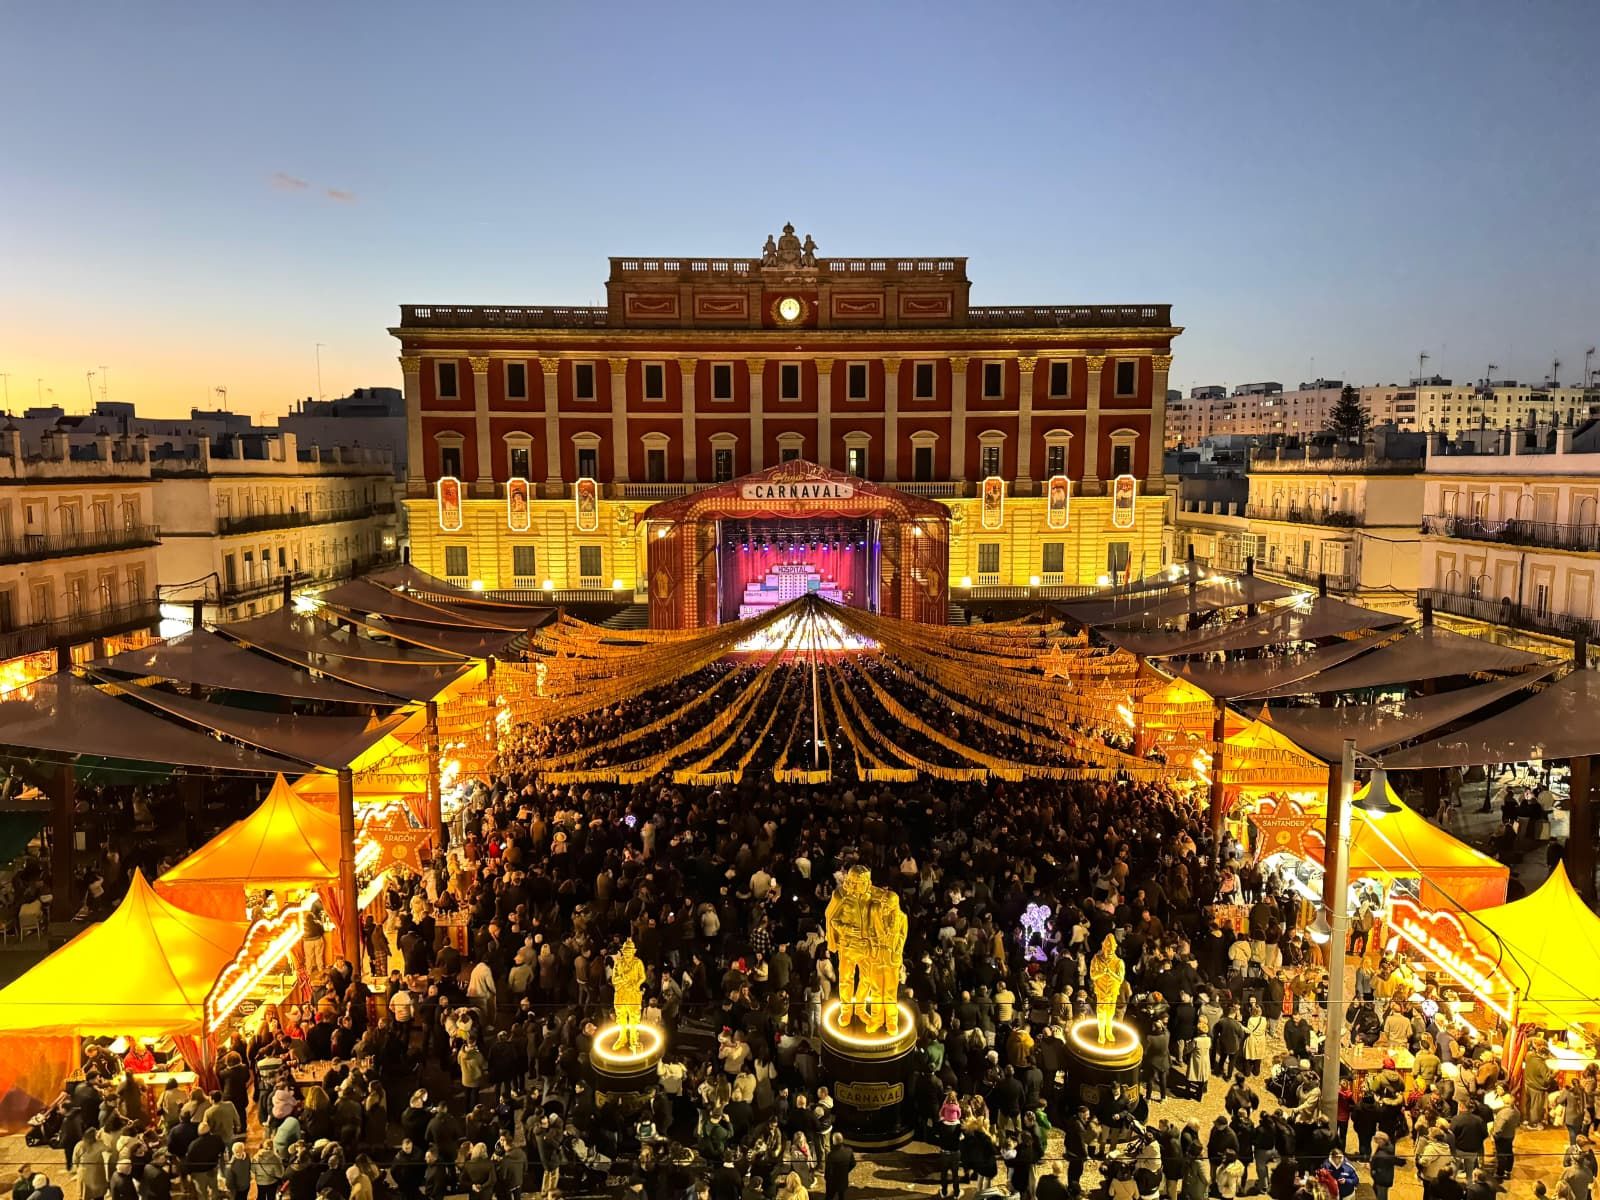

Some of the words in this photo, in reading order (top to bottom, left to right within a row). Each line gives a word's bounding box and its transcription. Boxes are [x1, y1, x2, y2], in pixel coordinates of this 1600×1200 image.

[755, 485, 841, 498] CARNAVAL
[778, 566, 808, 574] HOSPITAL
[383, 834, 417, 842] ARAGÓN
[839, 1087, 901, 1103] CARNAVAL
